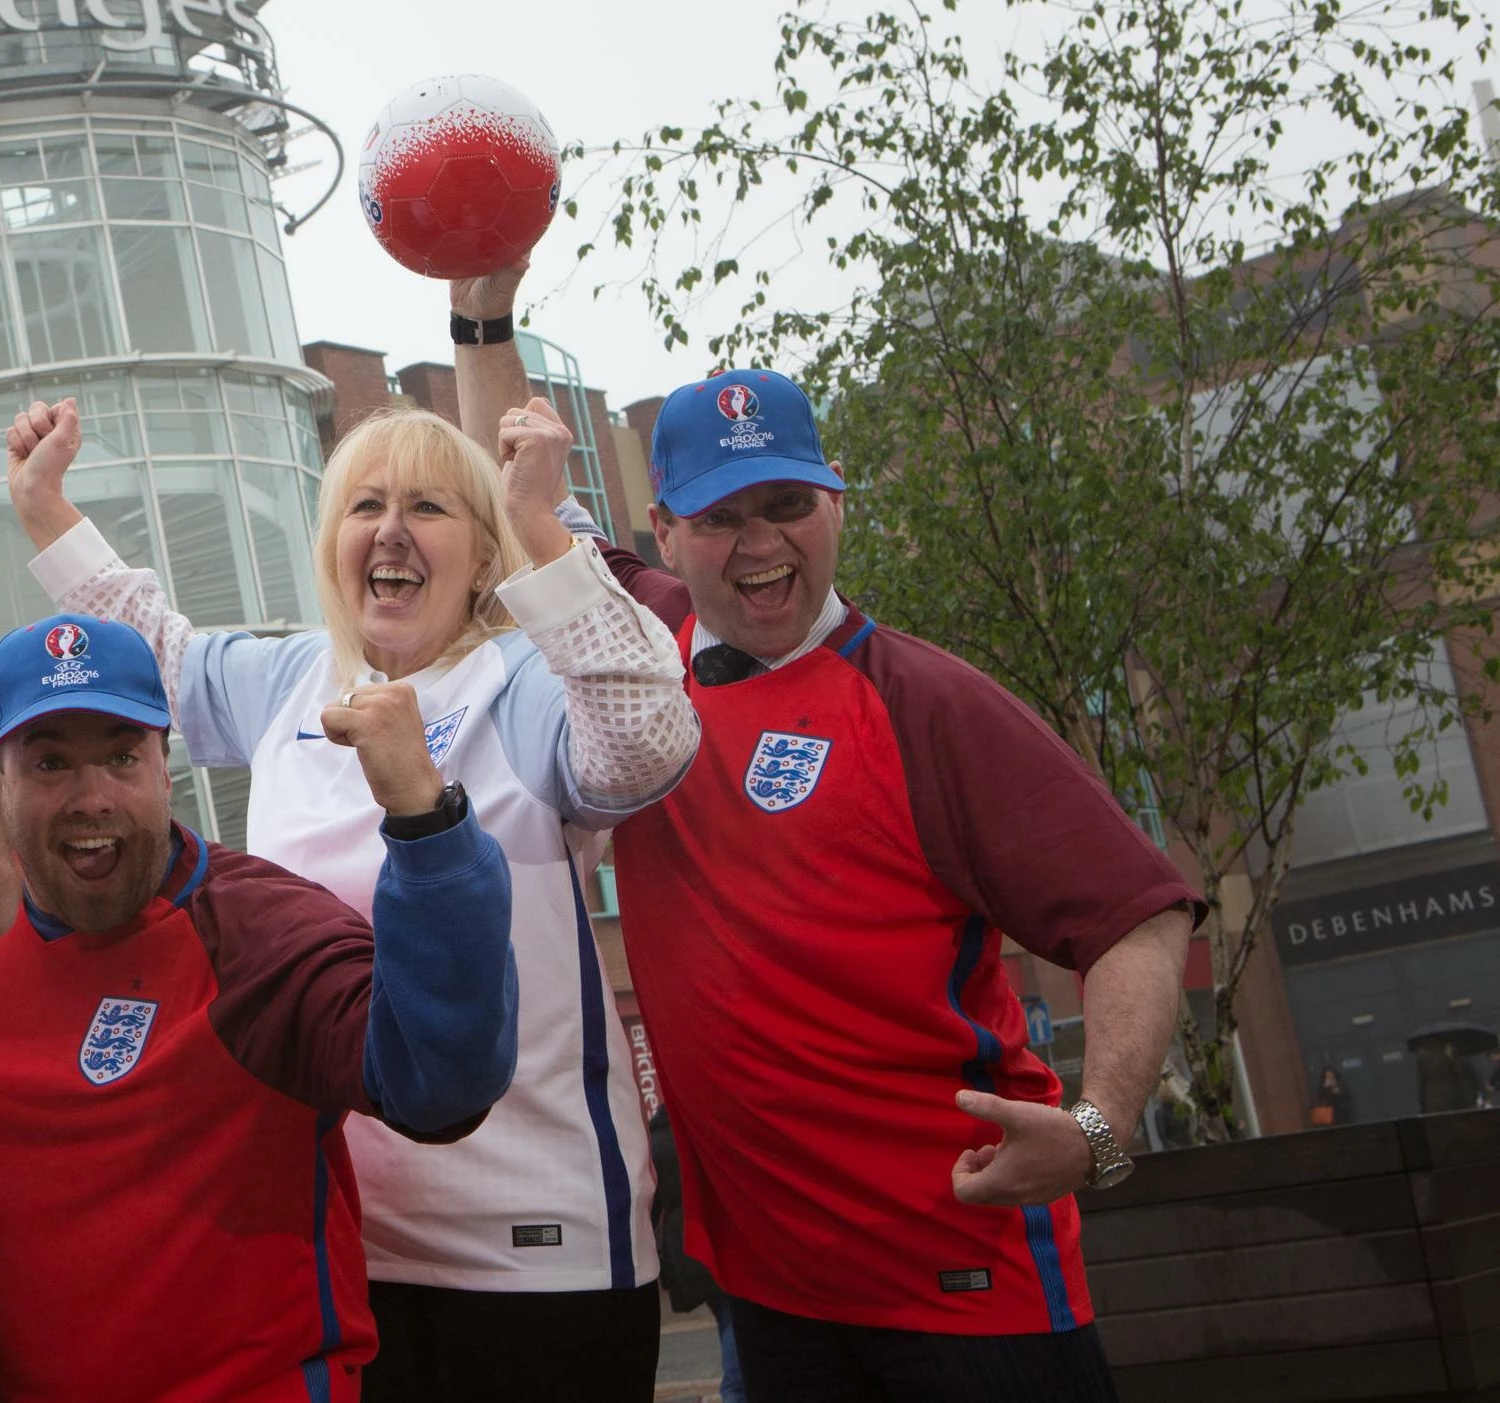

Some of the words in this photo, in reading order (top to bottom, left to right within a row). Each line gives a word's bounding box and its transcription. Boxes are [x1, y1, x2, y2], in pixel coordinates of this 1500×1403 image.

[733, 424, 756, 433] UEFA
[720, 432, 774, 448] EURO2016
[732, 440, 767, 451] FRANCE
[56, 662, 81, 672] UEFA
[42, 670, 100, 685] EURO2016
[52, 677, 90, 688] FRANCE
[1288, 886, 1495, 945] DEBENHAMS
